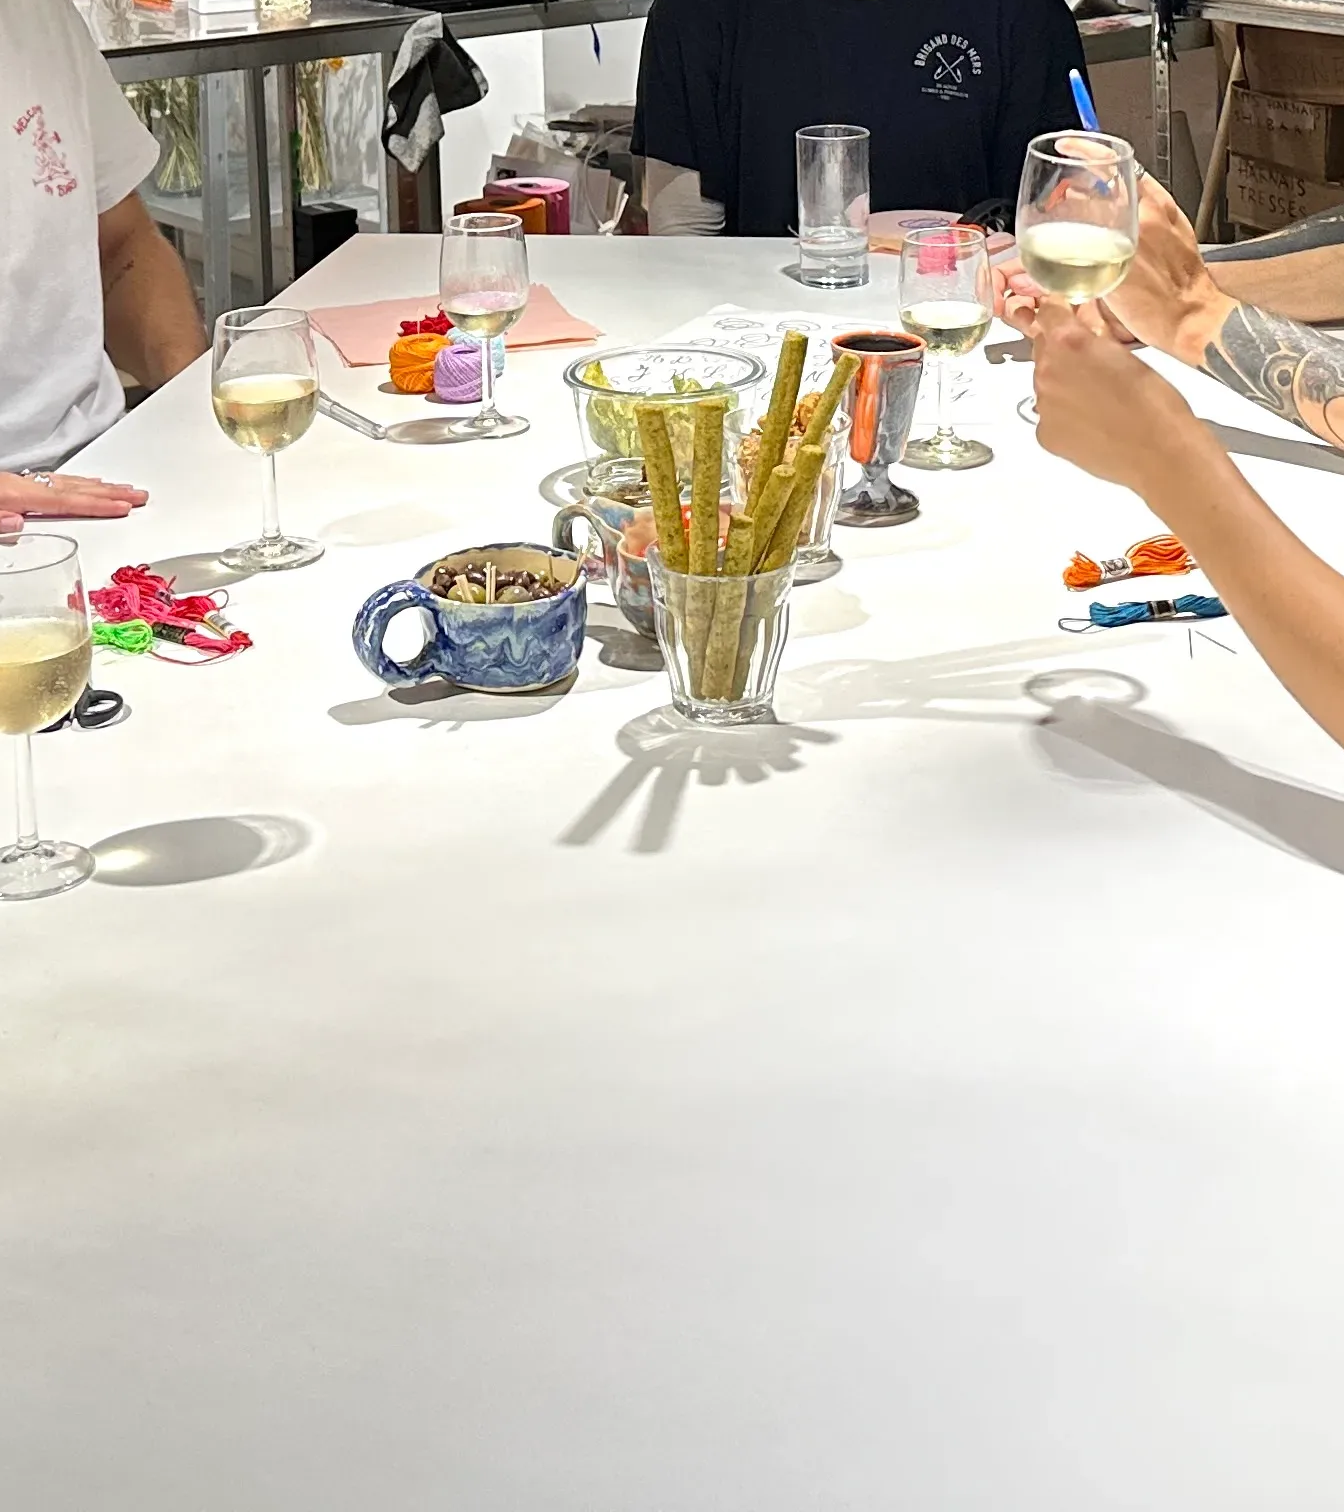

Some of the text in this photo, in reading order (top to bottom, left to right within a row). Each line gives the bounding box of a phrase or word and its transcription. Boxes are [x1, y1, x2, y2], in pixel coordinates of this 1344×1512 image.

[913, 33, 982, 75] BRIGAND DES MERS
[1237, 158, 1307, 197] HARNAIS
